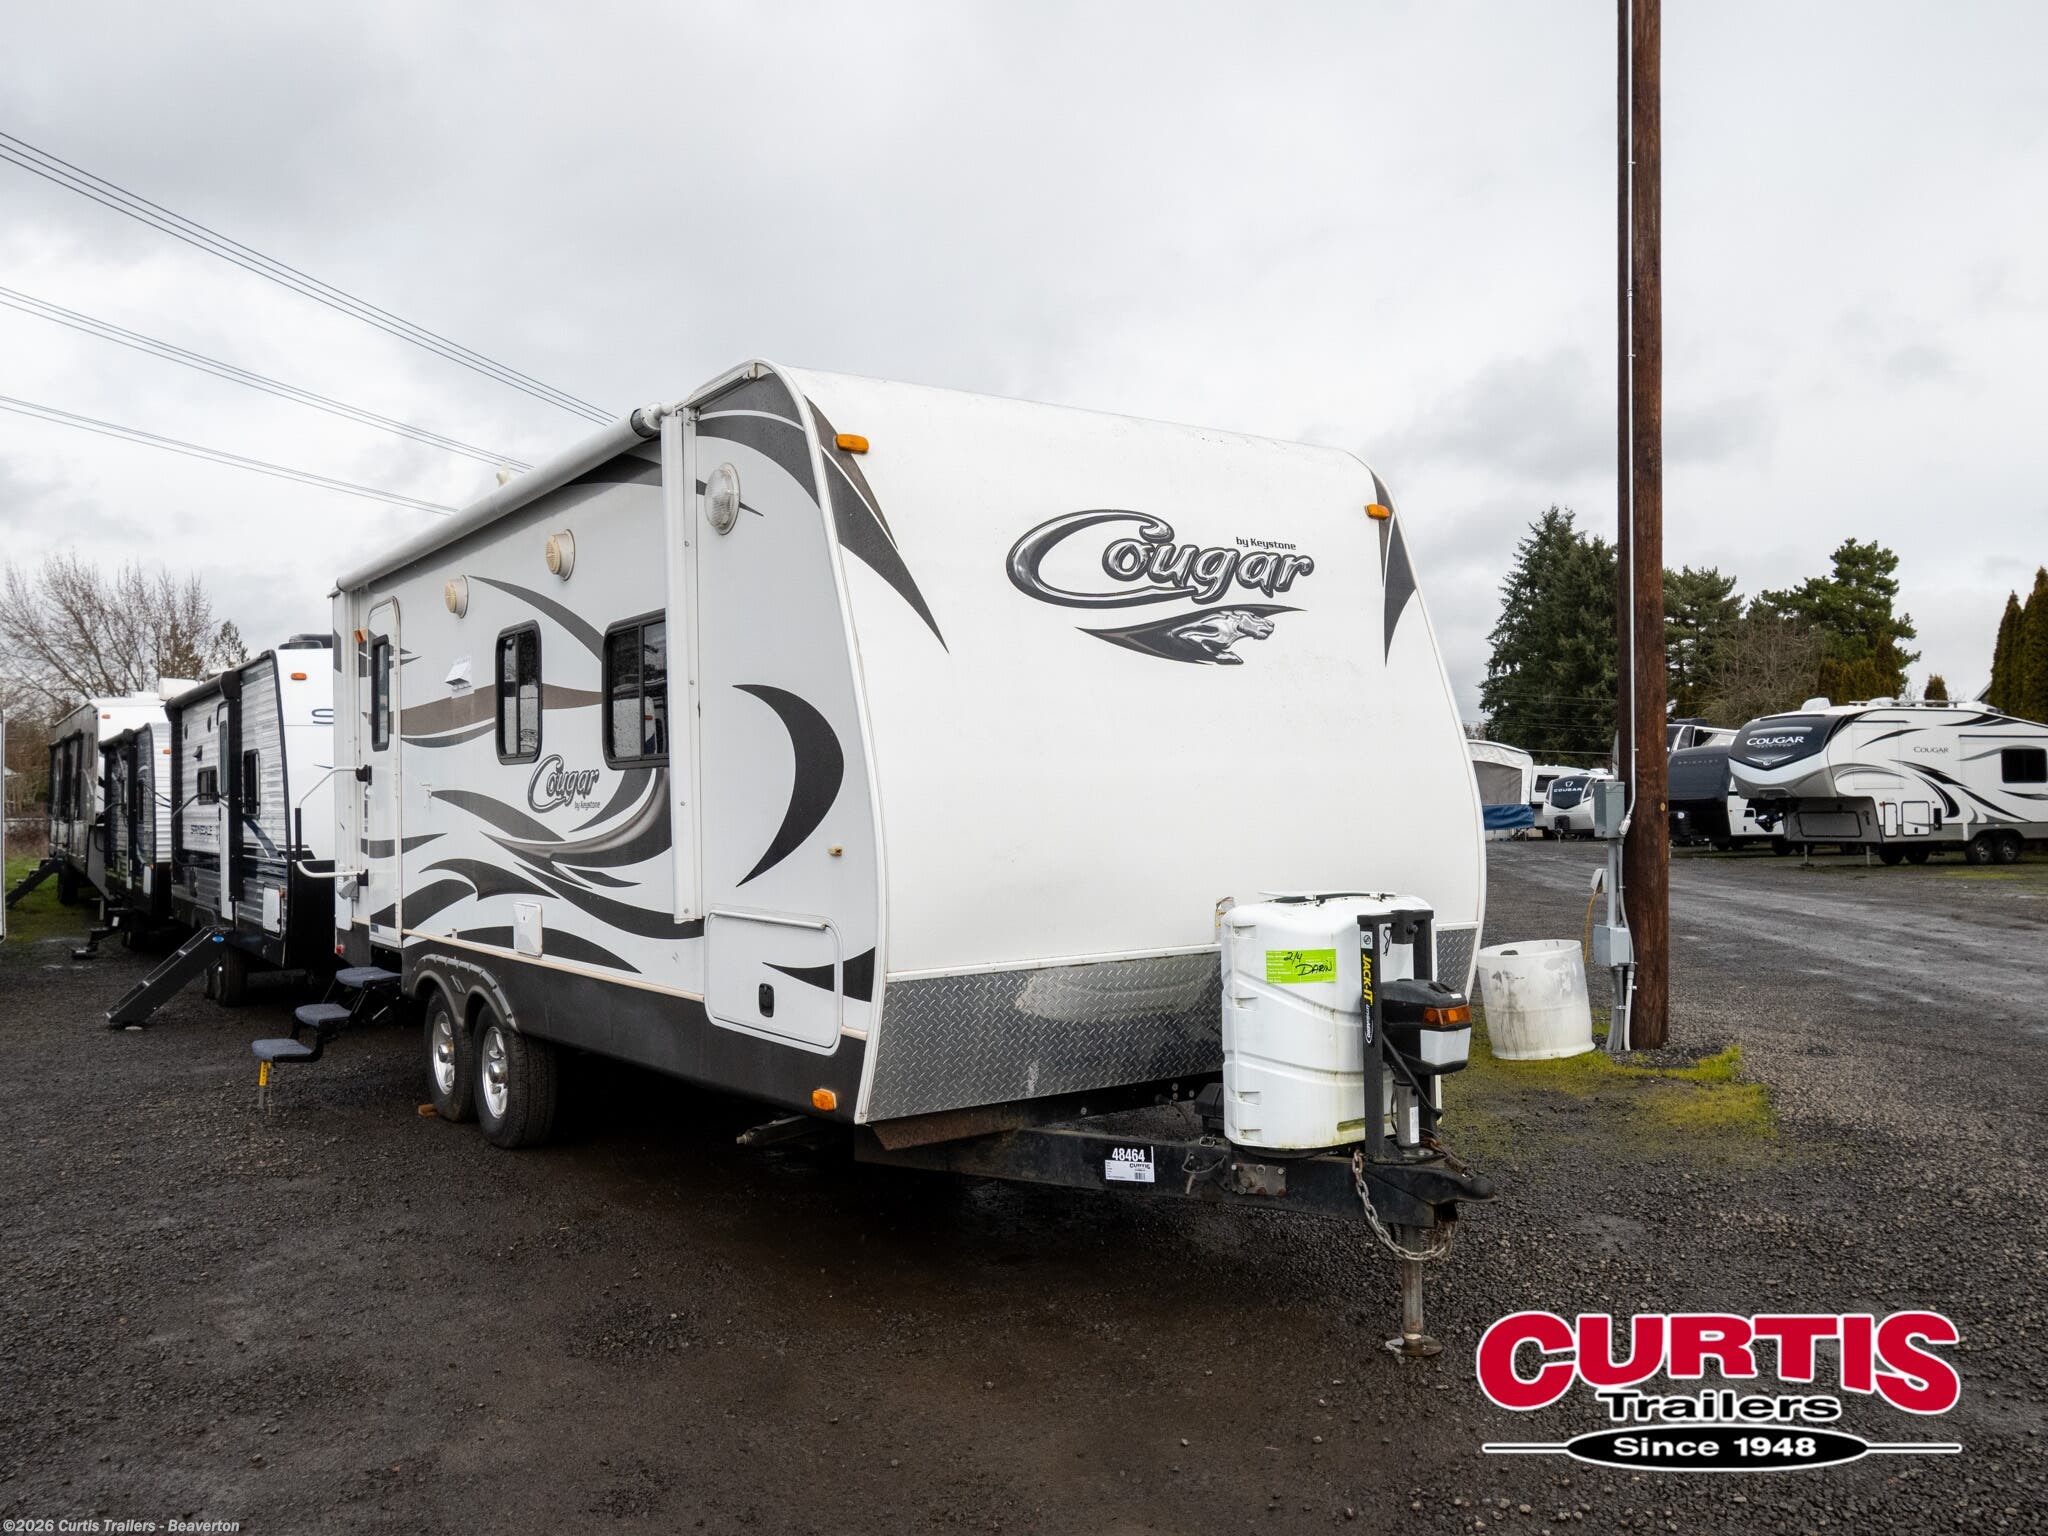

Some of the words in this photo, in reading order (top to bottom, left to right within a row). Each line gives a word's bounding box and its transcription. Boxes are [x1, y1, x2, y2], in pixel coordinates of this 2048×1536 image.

[1006, 508, 1315, 609] Cougar
[1236, 537, 1249, 548] by
[1250, 538, 1297, 551] Keystone
[1746, 736, 1804, 746] COUGAR
[528, 754, 599, 813] Cougar
[1363, 954, 1374, 1005] JACK-IT
[1112, 1147, 1146, 1162] 48464
